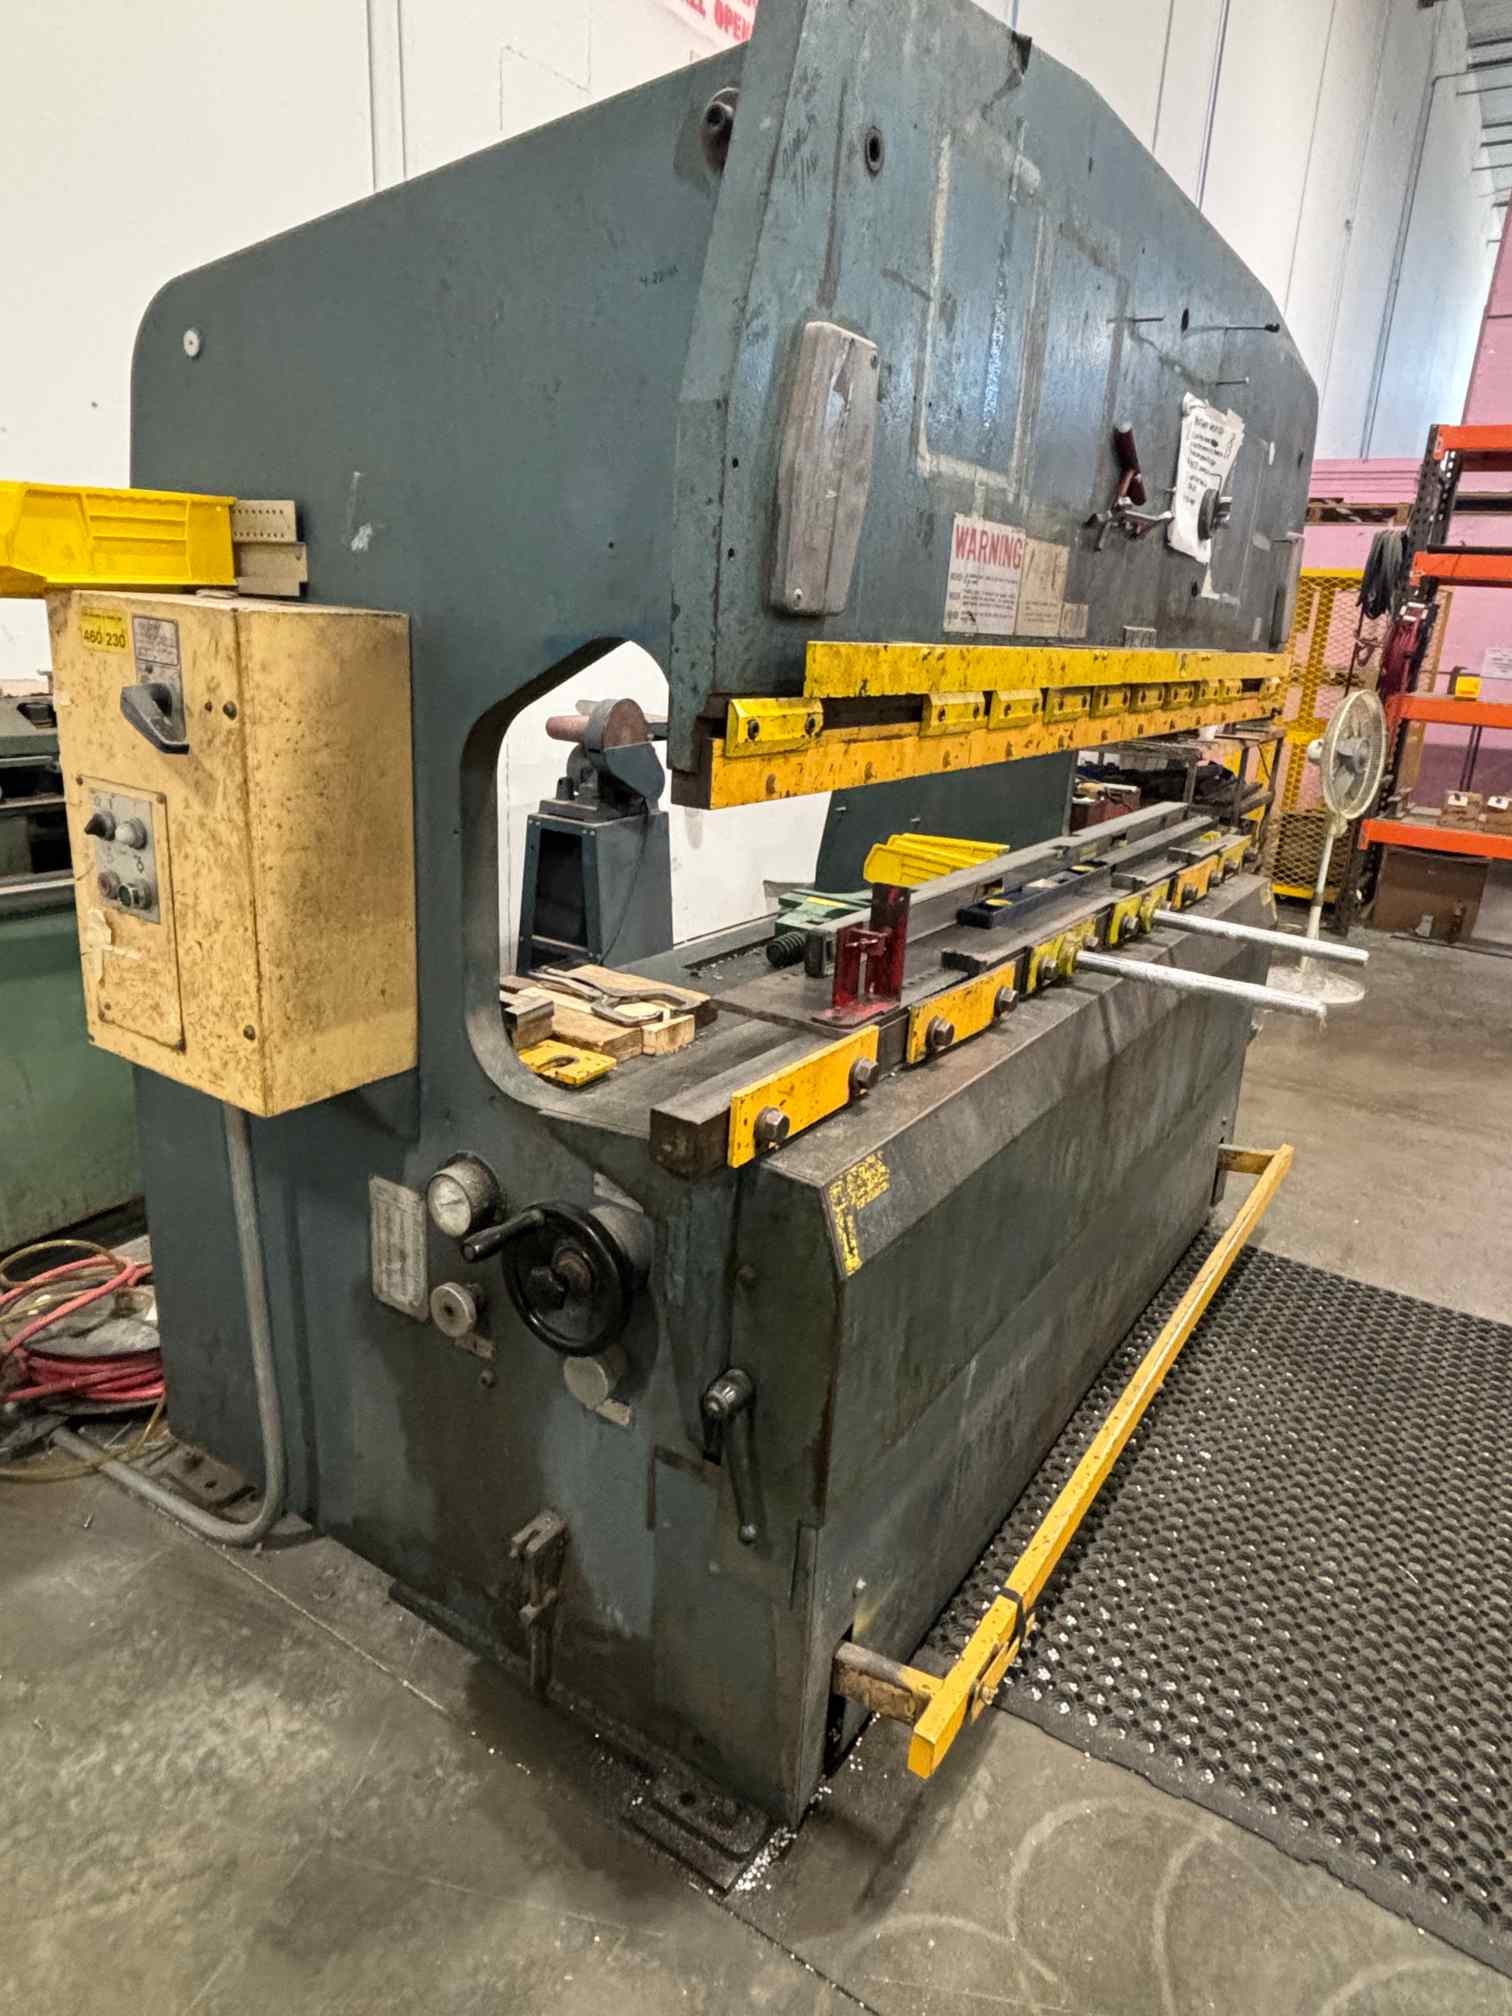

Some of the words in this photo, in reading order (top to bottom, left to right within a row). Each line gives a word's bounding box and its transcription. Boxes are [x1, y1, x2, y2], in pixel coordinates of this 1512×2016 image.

[955, 526, 1023, 570] WARNING
[83, 629, 103, 645] 460
[106, 632, 126, 649] 230
